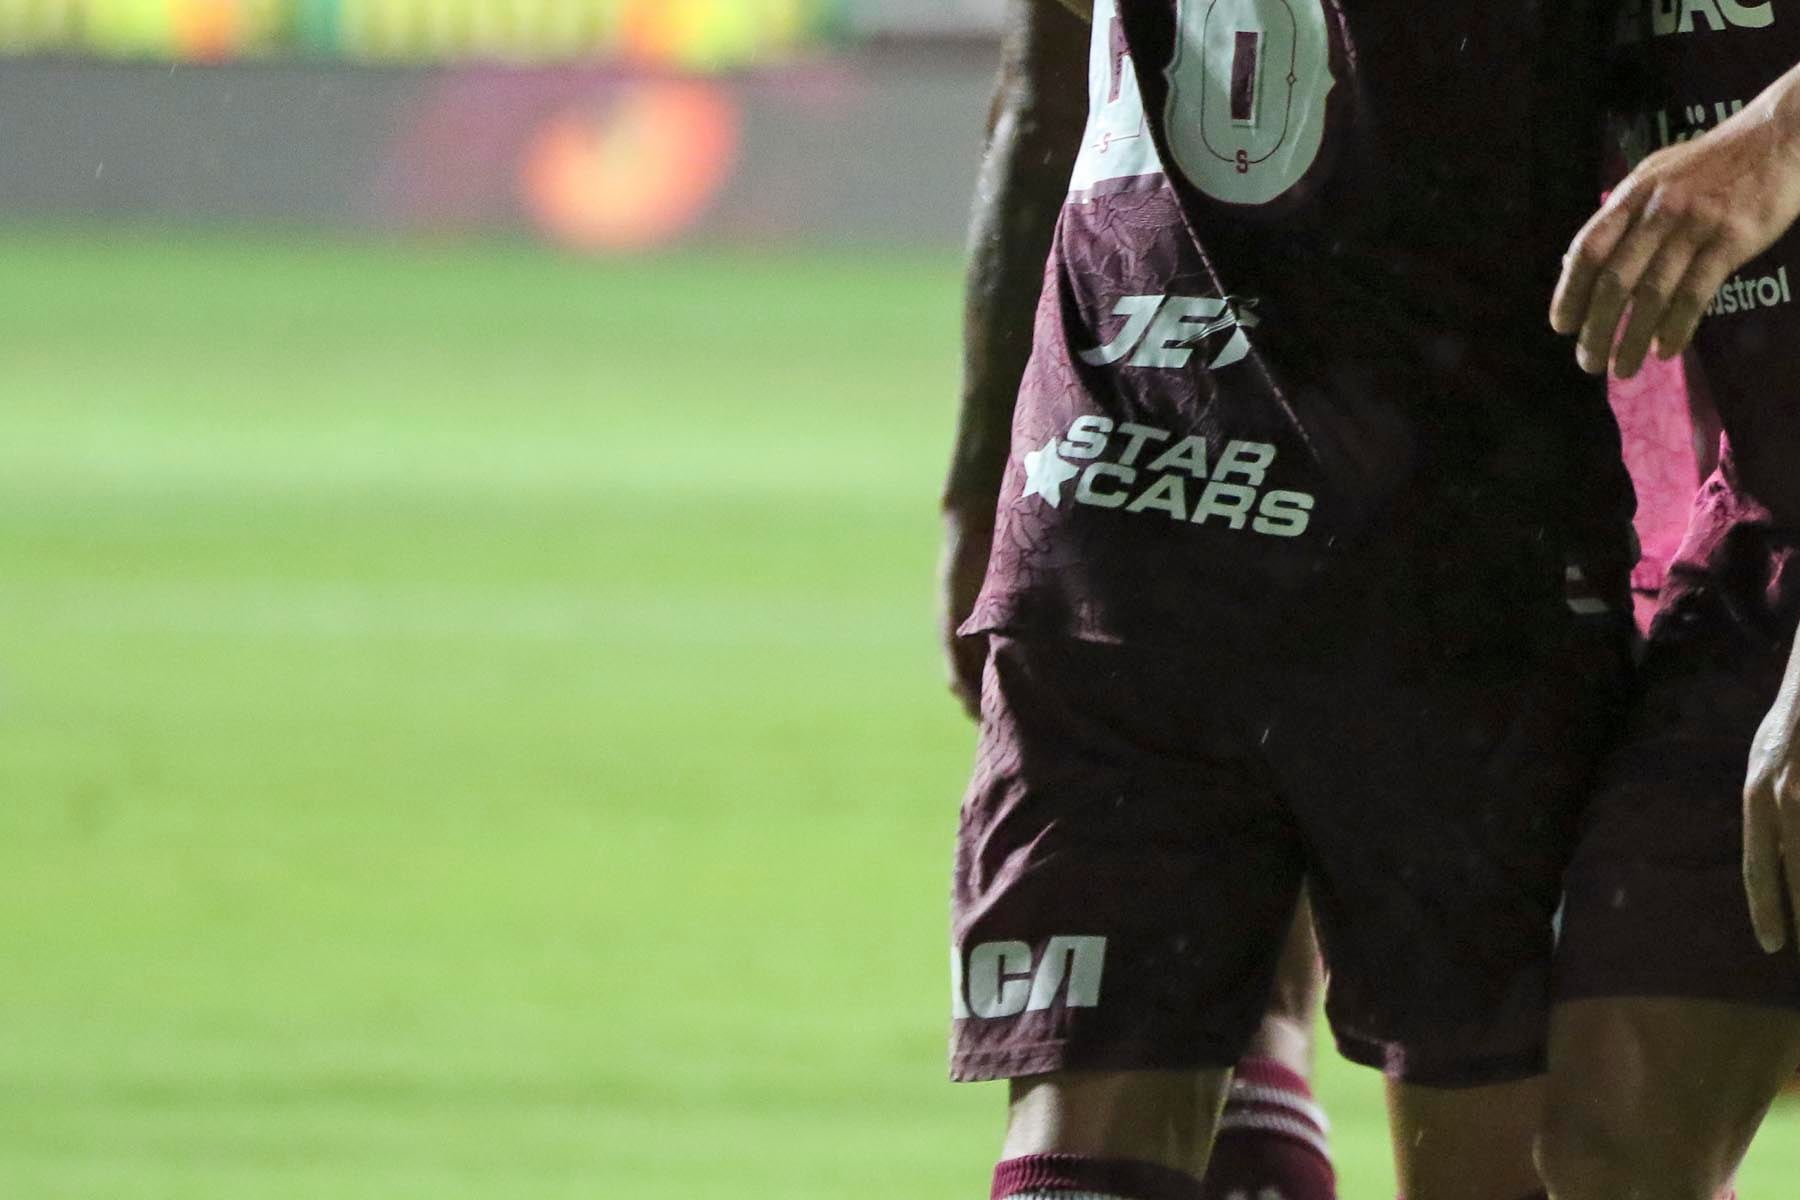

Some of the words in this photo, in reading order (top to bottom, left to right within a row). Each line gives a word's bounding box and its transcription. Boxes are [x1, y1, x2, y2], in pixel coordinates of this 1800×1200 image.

[1236, 149, 1249, 174] S
[1707, 265, 1791, 316] strol
[1057, 415, 1278, 487] STAR
[1075, 461, 1315, 537] CARS
